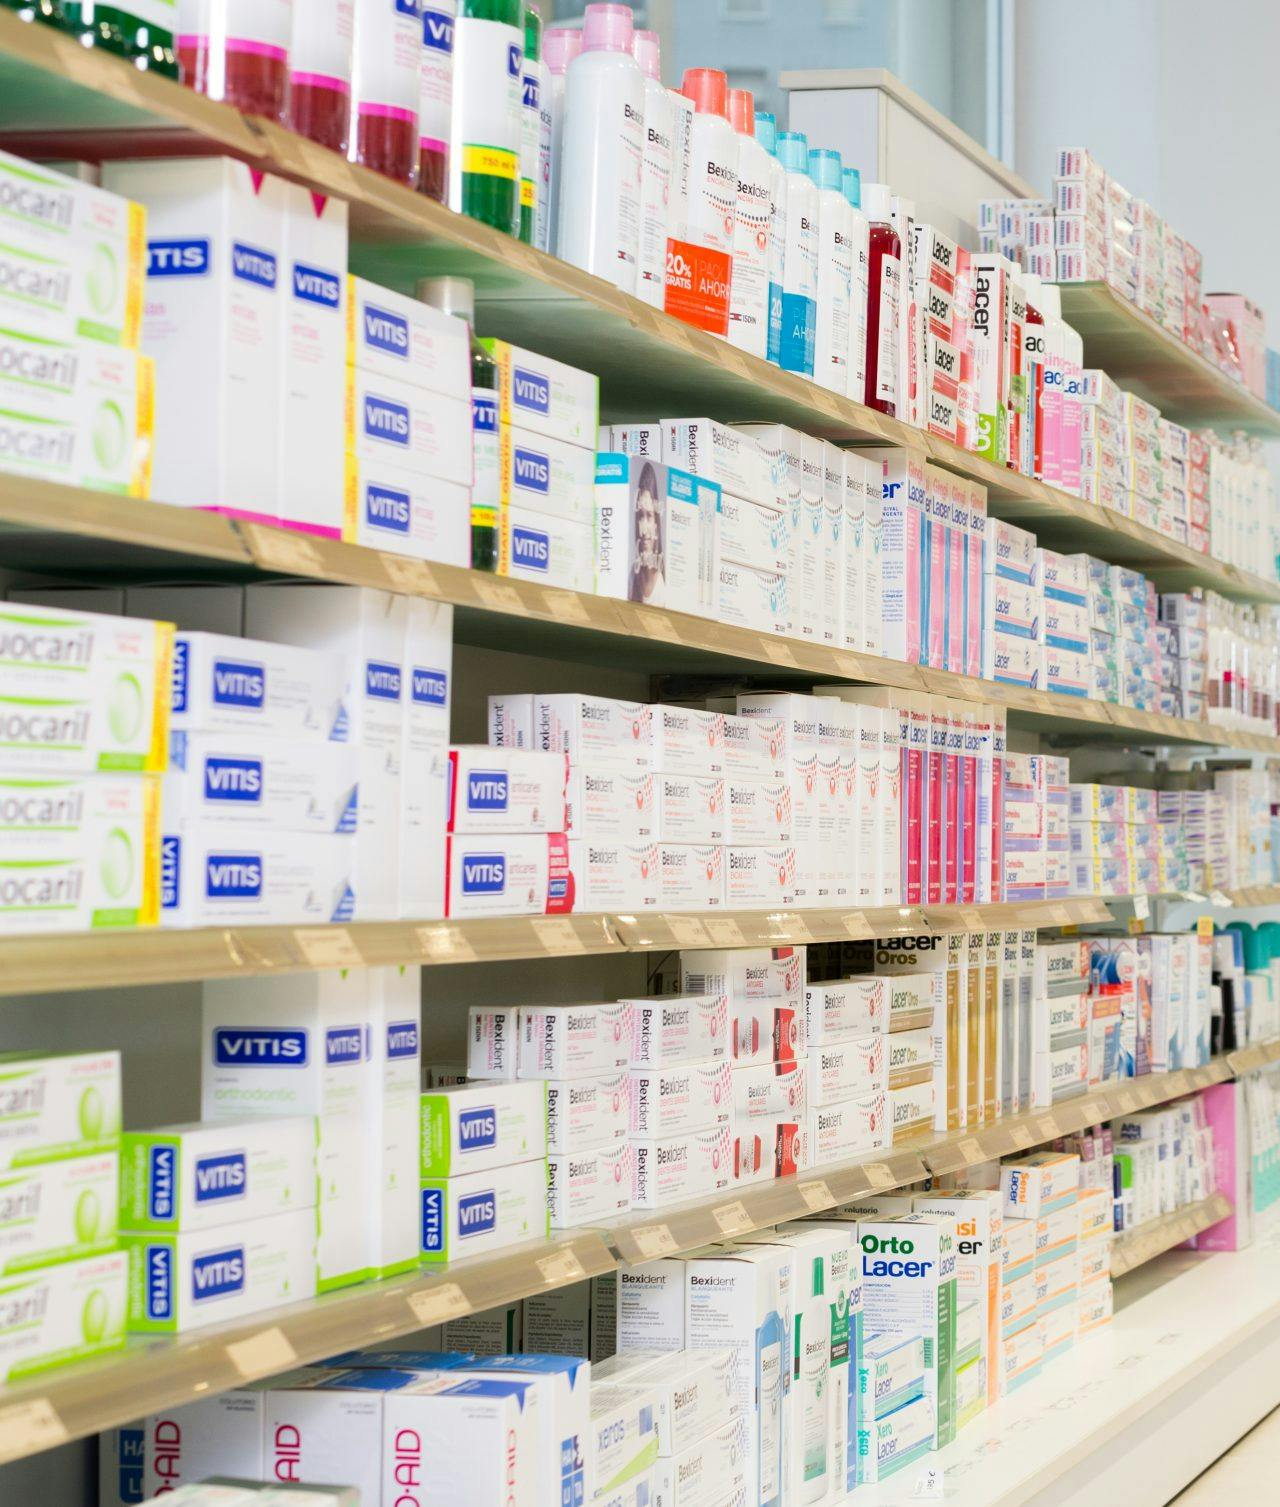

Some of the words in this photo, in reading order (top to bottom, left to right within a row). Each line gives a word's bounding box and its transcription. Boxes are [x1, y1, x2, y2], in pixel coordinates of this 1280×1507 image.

[147, 246, 205, 272] ITIS
[932, 233, 952, 265] Lacer
[233, 250, 276, 282] VITIS
[666, 253, 691, 276] 20%
[294, 272, 339, 302] VITIS
[666, 275, 691, 290] GRATIS
[929, 288, 949, 317] Lacer
[975, 266, 995, 337] Lacer
[366, 316, 408, 350] VITIS
[935, 342, 954, 372] Lacer
[515, 378, 548, 405] VITIS
[932, 397, 952, 427] Lacer
[366, 406, 408, 439] VITIS
[688, 424, 698, 475] Bexident
[516, 456, 548, 483] VITIS
[908, 481, 925, 504] Lacer
[368, 495, 409, 527] VITIS
[932, 496, 950, 517] Lacer
[951, 505, 968, 526] Lacer
[514, 536, 548, 561] VITIS
[601, 507, 612, 574] Bexident
[214, 670, 264, 698] VITIS
[367, 672, 400, 691] VITIS
[413, 676, 446, 696] VITIS
[581, 704, 610, 722] Bexident
[663, 712, 689, 730] Bexident
[793, 720, 816, 735] Bexident
[910, 726, 927, 743] Lacer
[930, 730, 946, 745] Lacer
[207, 767, 260, 792] VITIS
[585, 774, 614, 793] Bexident
[664, 781, 690, 798] Bexident
[470, 781, 507, 800] VITIS
[730, 788, 756, 806] Bexident
[589, 848, 618, 865] Bexident
[661, 850, 688, 866] Bexident
[730, 851, 757, 870] Bexident
[163, 842, 176, 905] VITIS
[209, 864, 260, 888] VITIS
[465, 864, 503, 883] VITIS
[876, 935, 941, 950] Lacer
[968, 934, 983, 949] Lacer
[876, 951, 917, 964] Oros
[746, 967, 768, 980] Bexident
[825, 993, 845, 1009] Bexident
[891, 988, 907, 1008] Lacer
[567, 1015, 597, 1030] Bexident
[662, 1009, 689, 1027] Bexident
[327, 1035, 361, 1055] VITIS
[388, 1030, 417, 1049] VITIS
[495, 1014, 505, 1071] Bexident
[545, 1015, 556, 1071] Bexident
[642, 1009, 652, 1062] Bexident
[222, 1038, 302, 1057] VITIS
[890, 1047, 906, 1065] Lacer
[822, 1054, 843, 1069] Bexident
[569, 1089, 597, 1104] Bexident
[660, 1077, 689, 1096] Bexident
[749, 1084, 771, 1097] Bexident
[639, 1079, 649, 1132] Bexident
[893, 1103, 910, 1122] Lacer
[461, 1117, 495, 1140] VITIS
[818, 1113, 842, 1129] Bexident
[657, 1147, 687, 1165] Bexident
[197, 1163, 245, 1190] VITIS
[569, 1161, 597, 1177] Bexident
[637, 1148, 647, 1202] Bexident
[156, 1151, 171, 1215] VITIS
[1010, 1170, 1020, 1204] Lacer
[427, 1194, 438, 1246] VITIS
[460, 1202, 494, 1226] VITIS
[861, 1235, 914, 1253] Orto
[940, 1236, 952, 1252] Orto
[194, 1261, 243, 1290] VITIS
[863, 1256, 933, 1277] Lacer
[939, 1257, 956, 1276] Lacer
[153, 1252, 168, 1315] VITIS
[622, 1274, 666, 1284] Bexident
[691, 1276, 735, 1286] Bexident
[806, 1339, 825, 1354] Bexident
[875, 1361, 888, 1377] Xero
[674, 1385, 698, 1409] Bexident
[875, 1377, 892, 1398] Lacer
[877, 1421, 892, 1437] Xero
[877, 1438, 897, 1459] Lacer
[679, 1456, 703, 1480] Bexident
